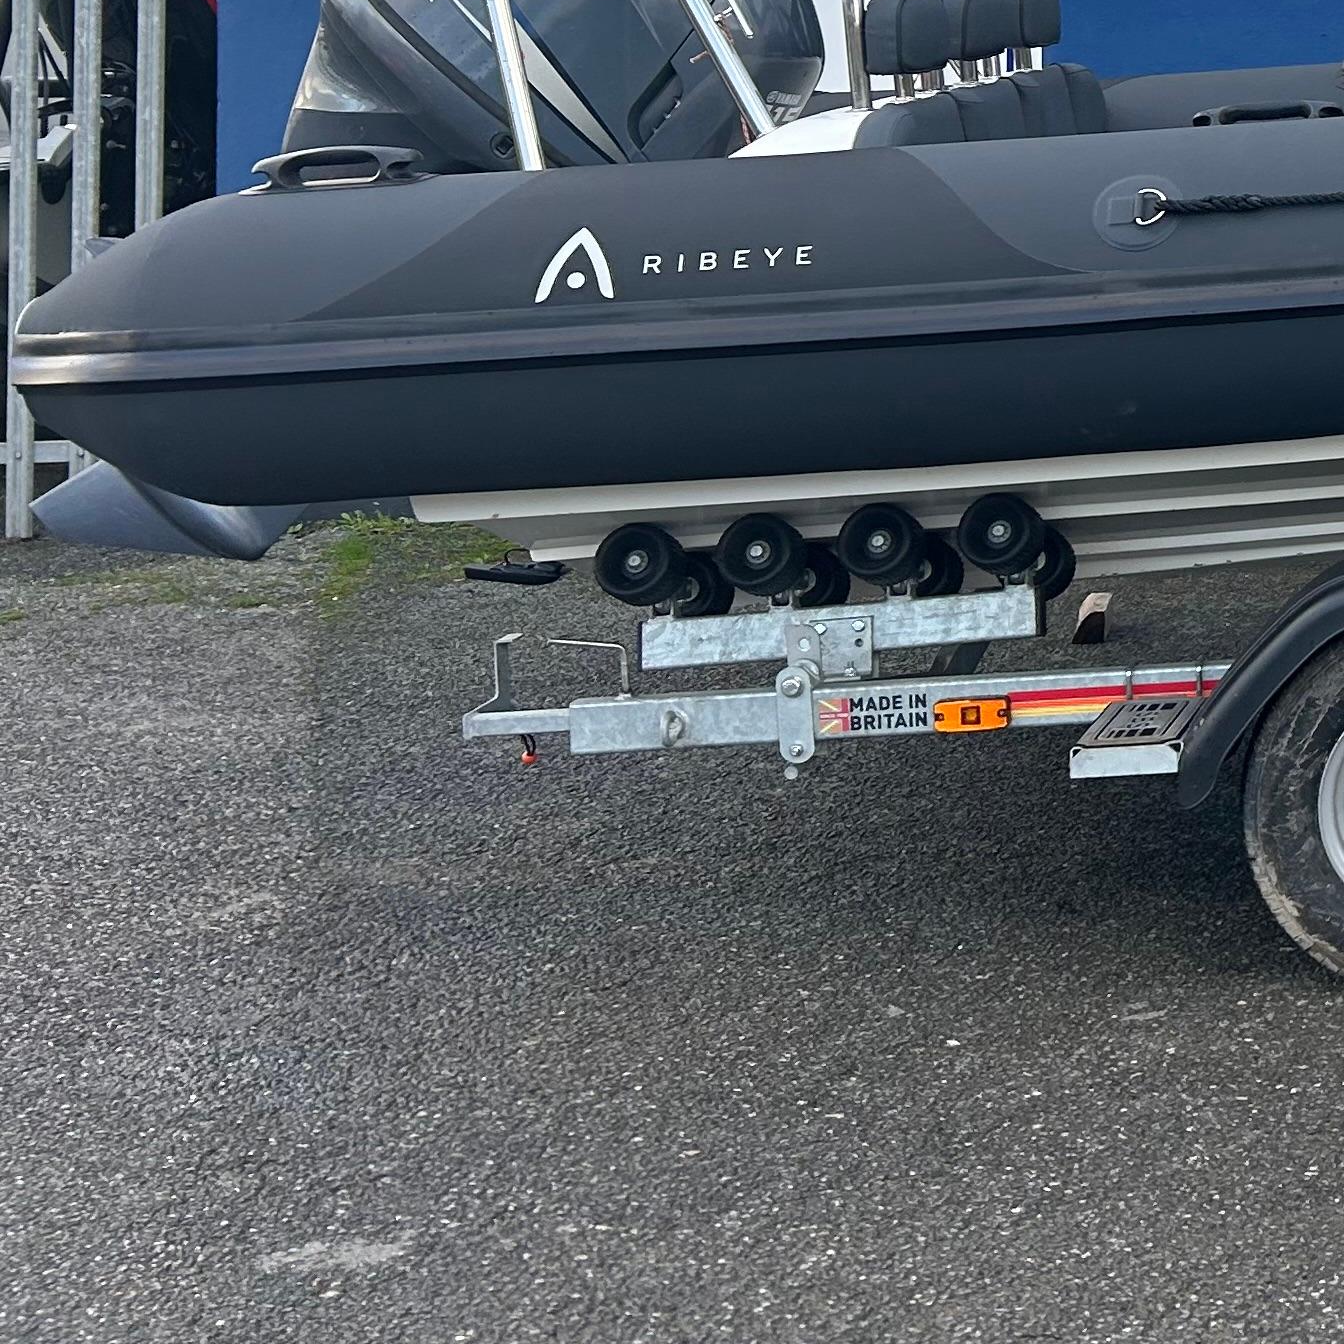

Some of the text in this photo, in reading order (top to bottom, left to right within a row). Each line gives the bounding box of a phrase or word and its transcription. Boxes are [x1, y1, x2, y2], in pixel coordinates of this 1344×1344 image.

[642, 246, 813, 274] RIBEYE
[849, 694, 927, 712] MADE IN
[849, 712, 928, 731] BRITAIN
